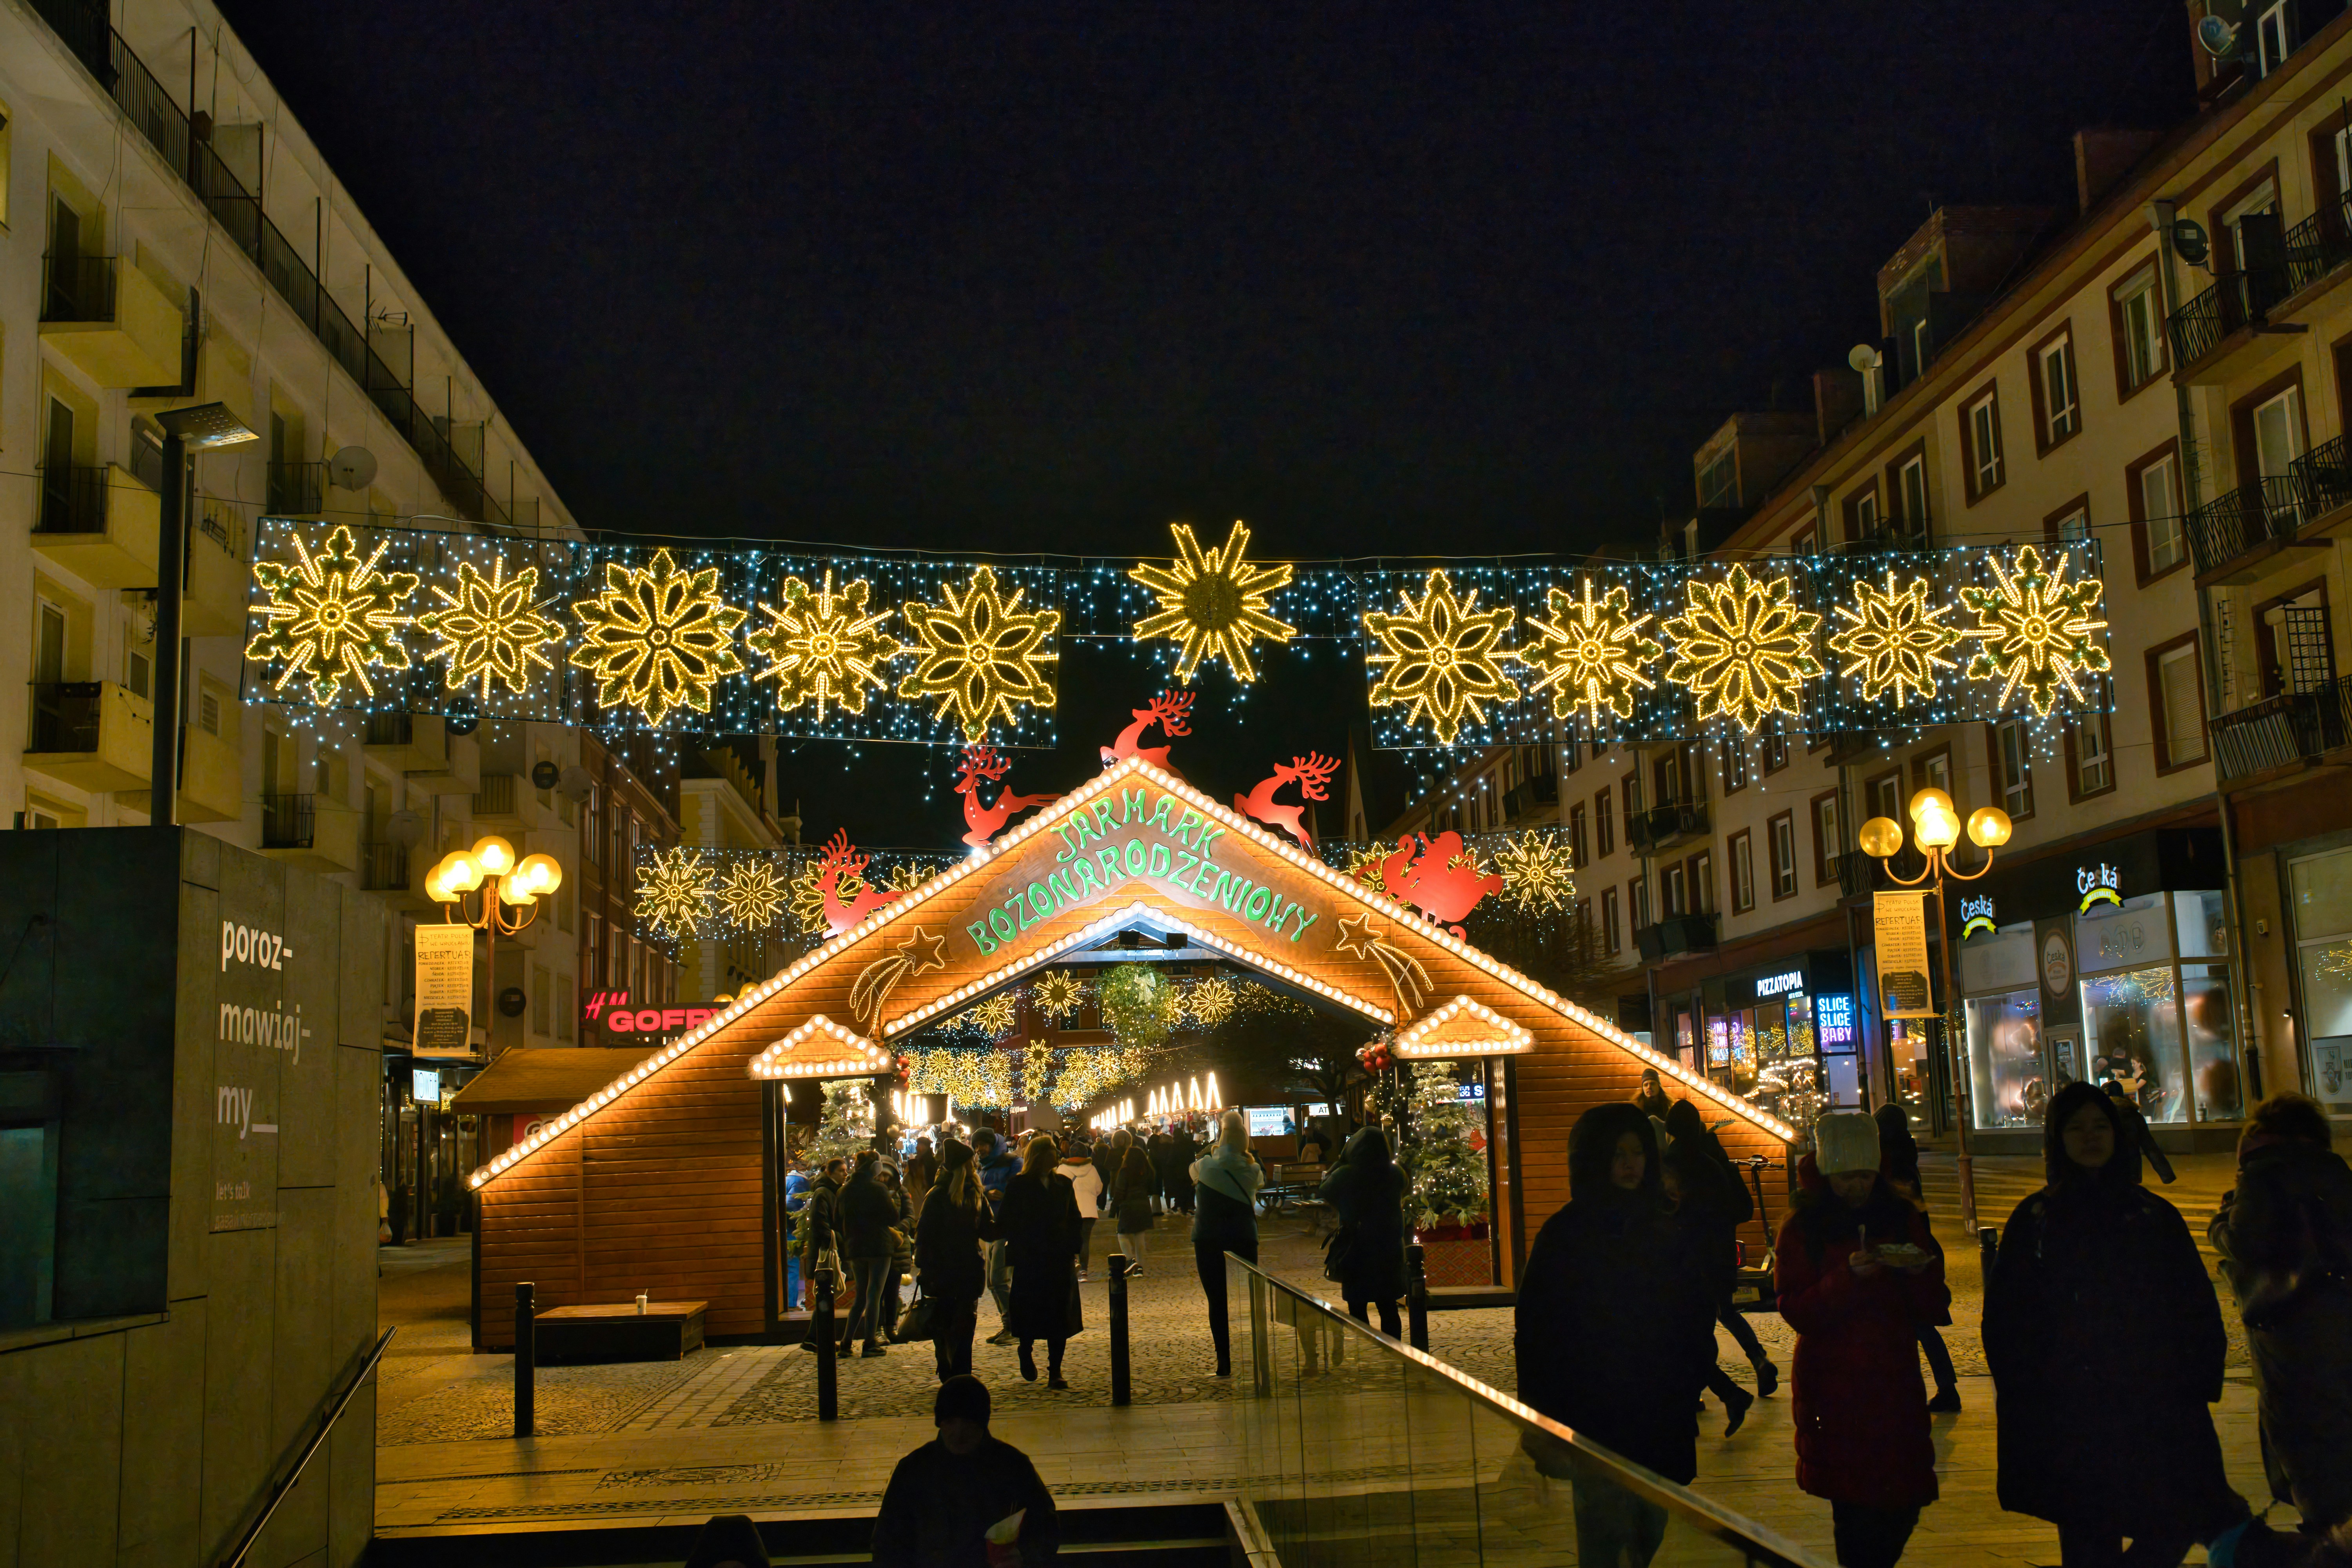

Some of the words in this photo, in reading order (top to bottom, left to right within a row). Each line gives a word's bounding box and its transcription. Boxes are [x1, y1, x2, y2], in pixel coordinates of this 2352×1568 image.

[1049, 788, 1226, 863] JARMARK
[2077, 863, 2117, 894] Česká
[966, 838, 1318, 956] BOŻONARODZENIOWY
[1960, 895, 1993, 922] Česká
[1875, 916, 1922, 926] REPERTUAR
[222, 920, 292, 972] poroz-
[418, 951, 471, 960] REPERTUAR
[1757, 971, 1803, 996] PIZZATOPIA
[1818, 997, 1849, 1011] SLICE
[608, 1008, 719, 1032] GOFR
[1820, 1013, 1851, 1026] SLICE
[220, 1000, 310, 1065] mawiaj-
[1822, 1027, 1851, 1042] BABY
[236, 1181, 250, 1200] talk
